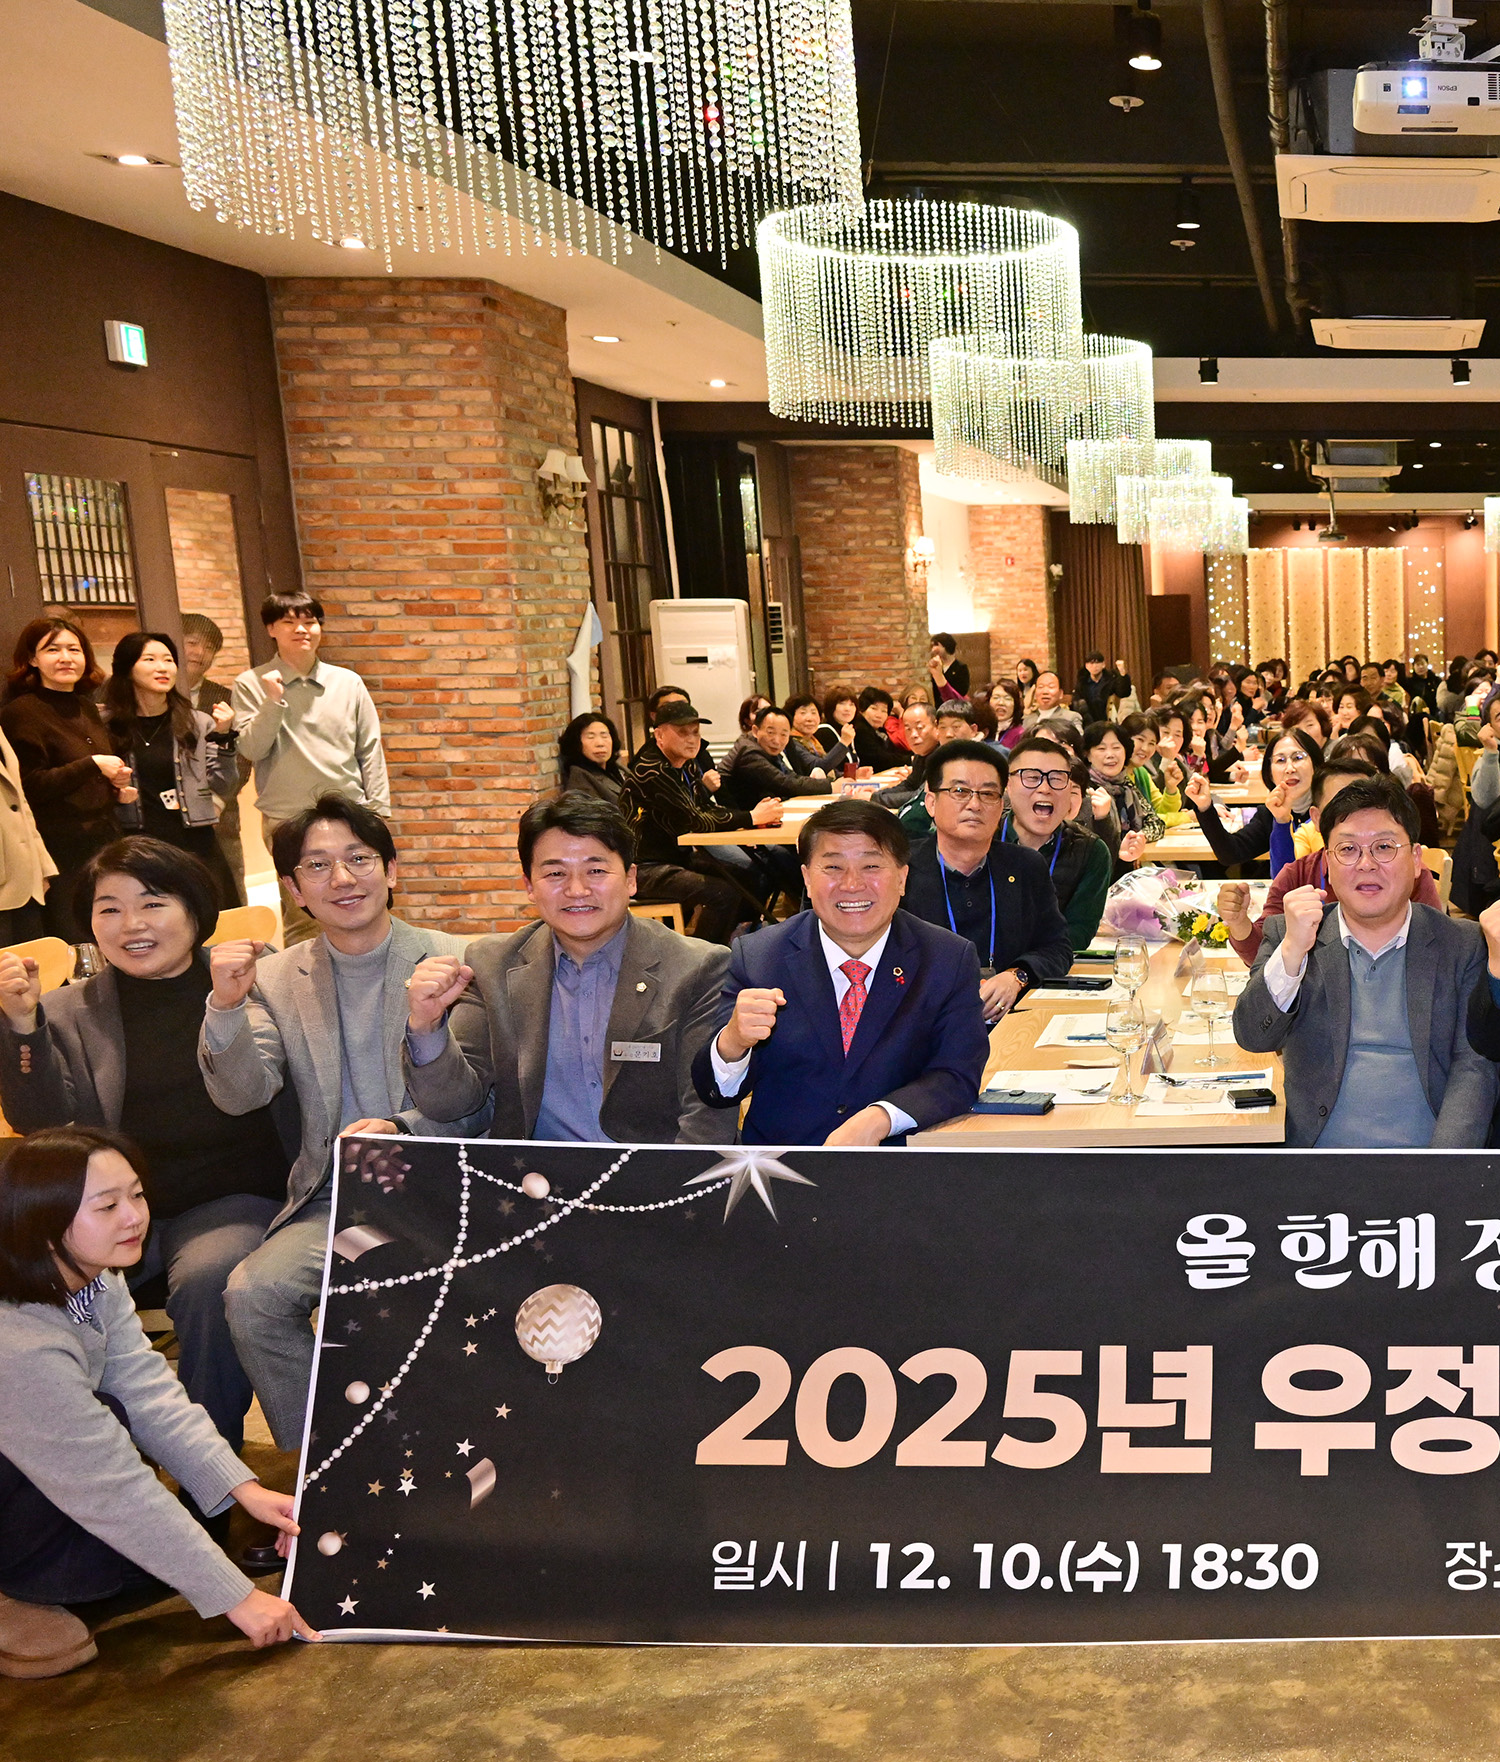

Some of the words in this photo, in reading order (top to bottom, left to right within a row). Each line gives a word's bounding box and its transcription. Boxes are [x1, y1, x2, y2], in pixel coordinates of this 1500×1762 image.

[1176, 1214, 1256, 1290] 올
[1278, 1213, 1436, 1290] 한해
[695, 1344, 1214, 1474] 2025년
[712, 1540, 808, 1591] 일시
[870, 1543, 951, 1590] 12.
[973, 1541, 1140, 1592] 10.(수)
[1162, 1542, 1320, 1591] 18:30
